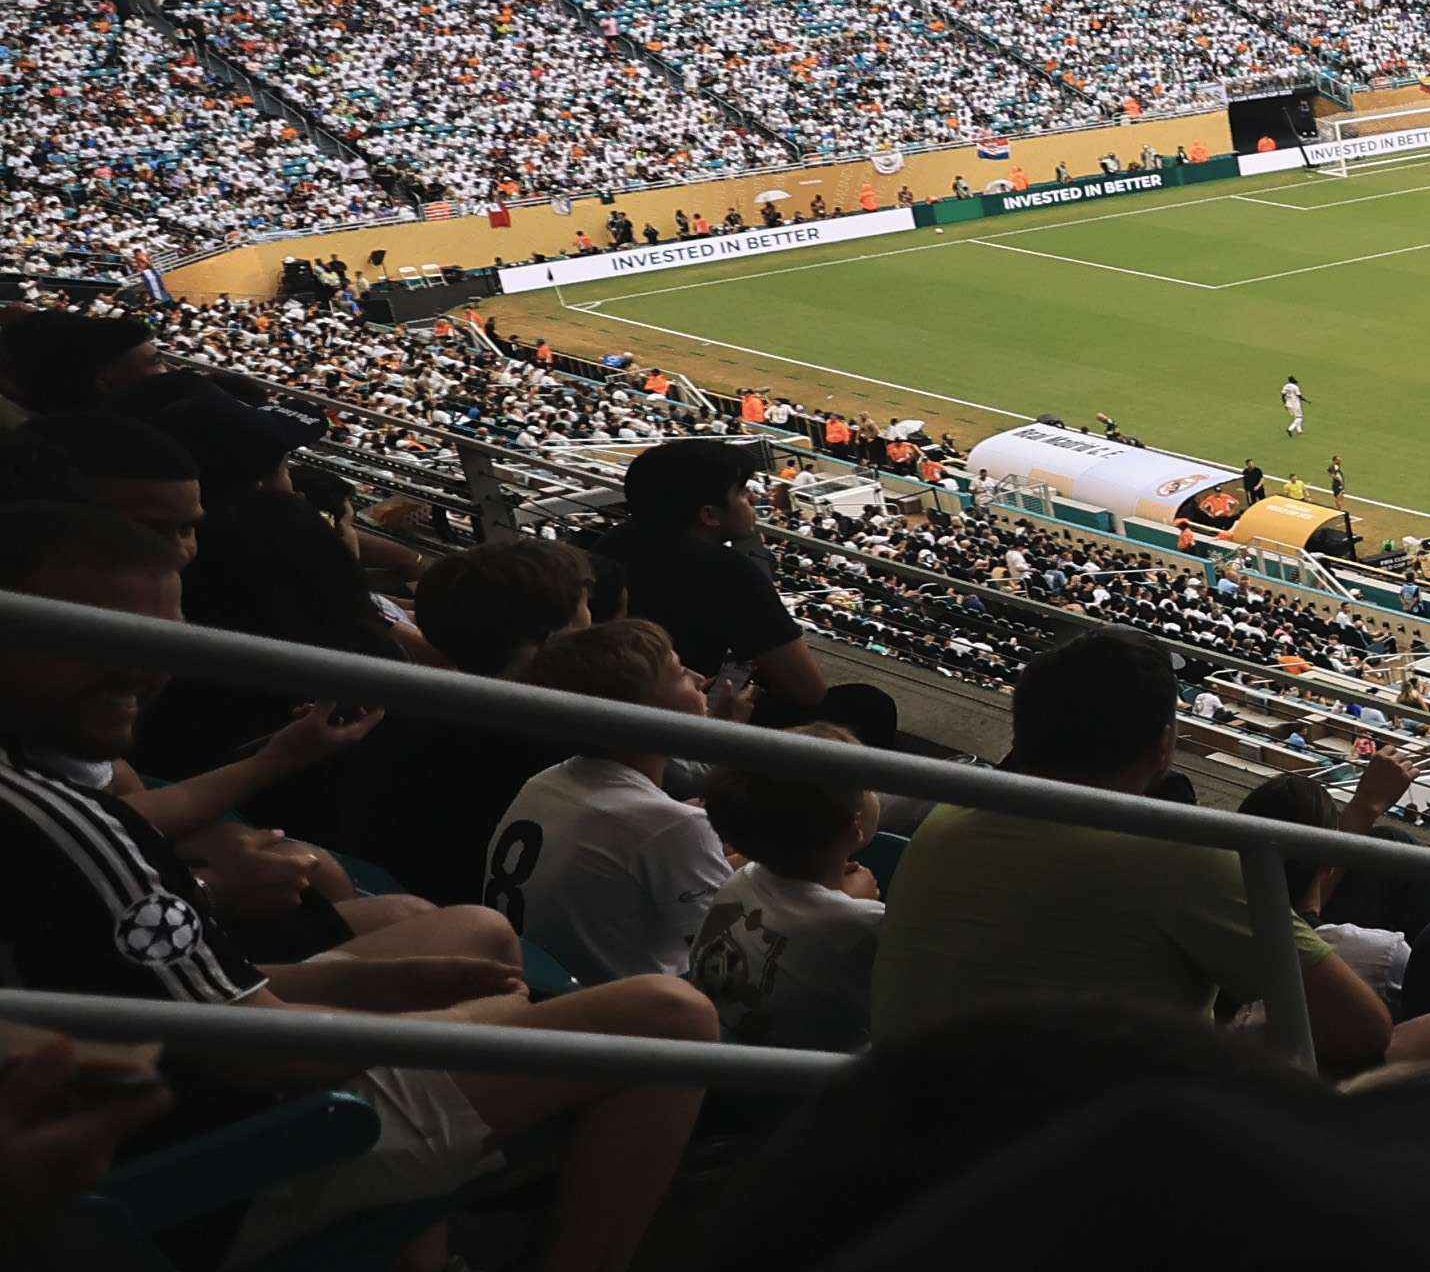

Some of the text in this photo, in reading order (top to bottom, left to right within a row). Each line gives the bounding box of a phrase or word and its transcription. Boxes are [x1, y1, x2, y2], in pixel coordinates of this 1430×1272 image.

[1311, 138, 1376, 160] INVESTED
[1380, 136, 1393, 147] IN
[1004, 174, 1163, 210] INVESTED IN BETTER
[612, 227, 820, 271] INVESTED IN BETTER
[484, 820, 545, 936] 8
